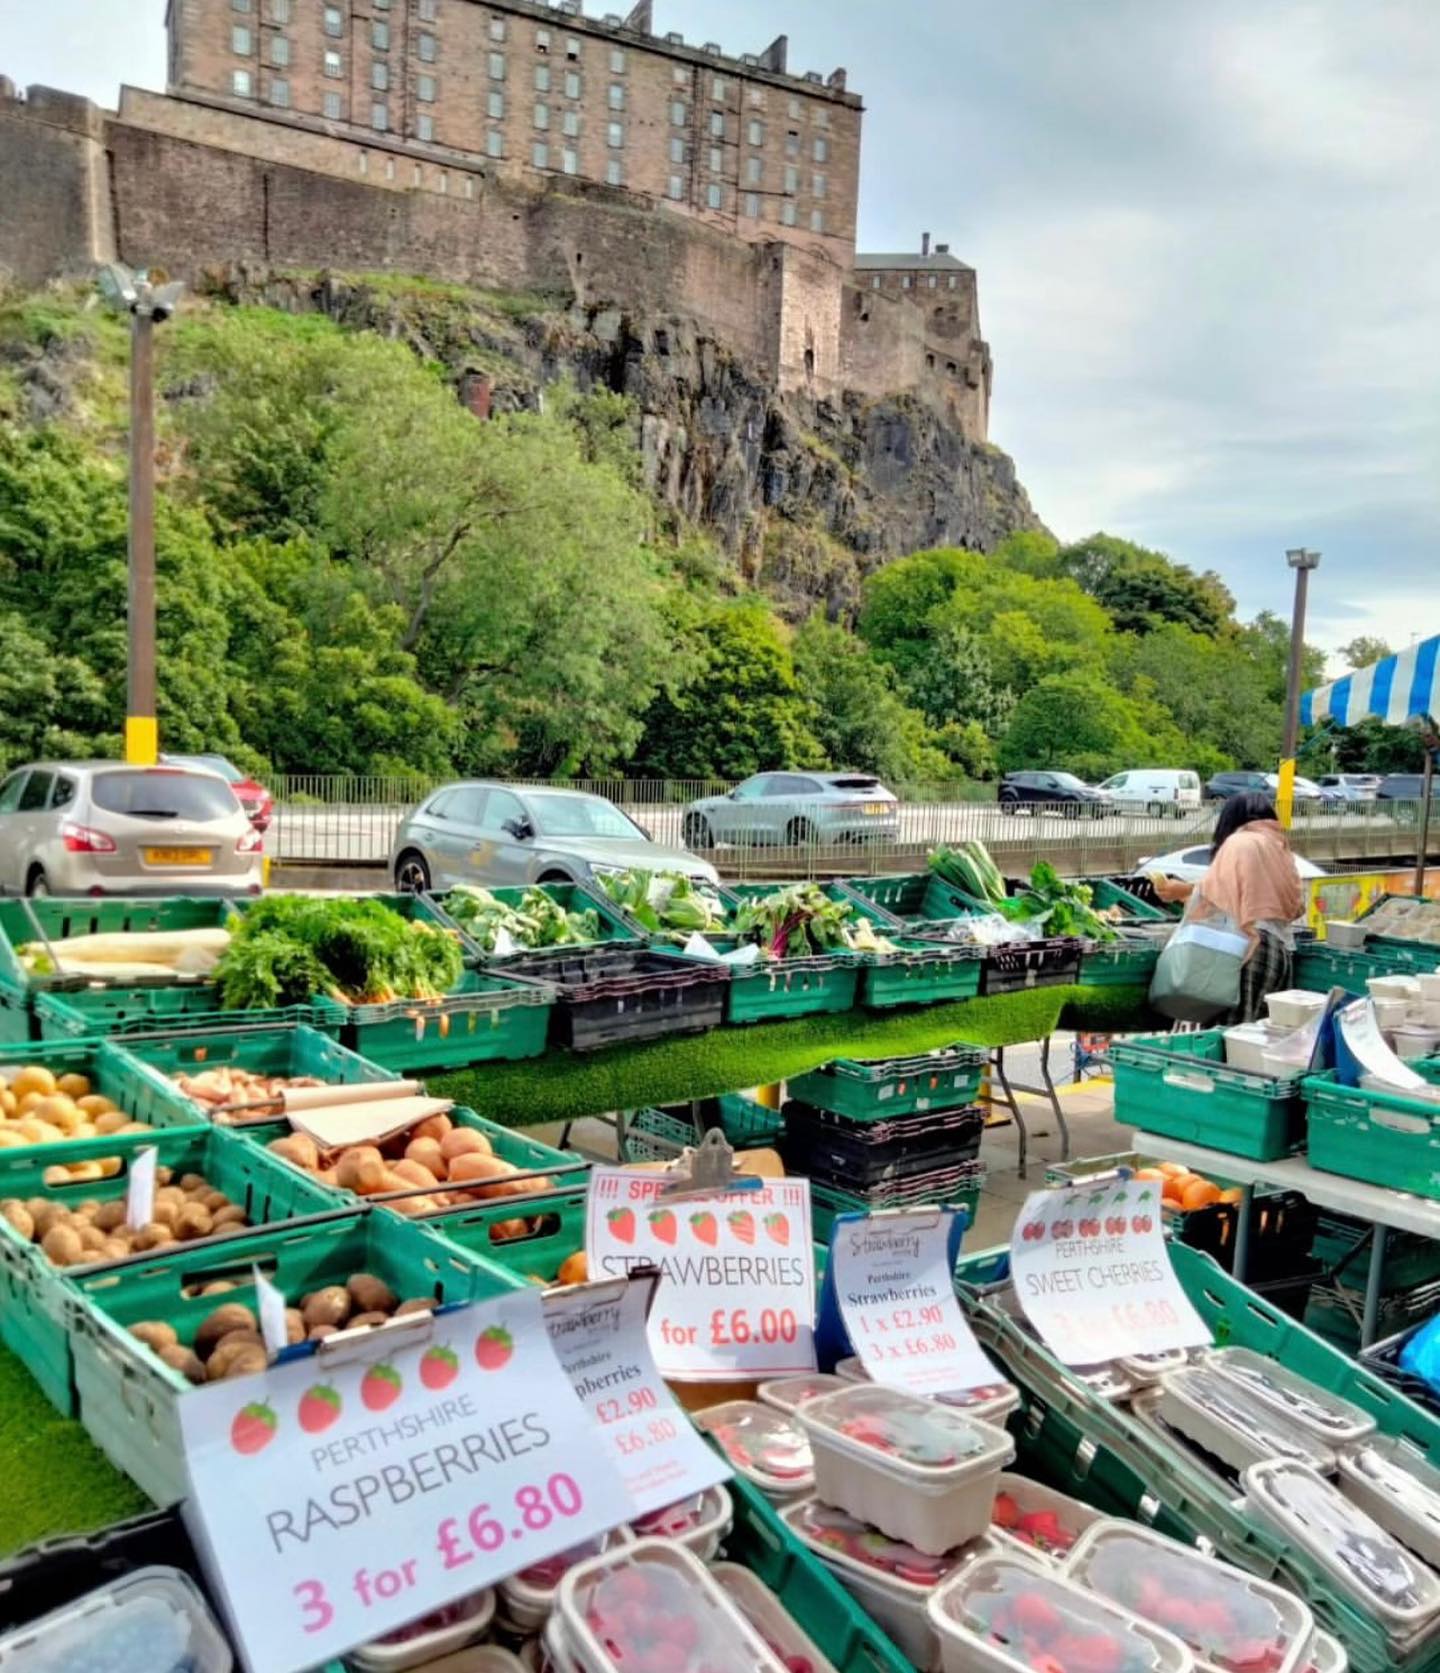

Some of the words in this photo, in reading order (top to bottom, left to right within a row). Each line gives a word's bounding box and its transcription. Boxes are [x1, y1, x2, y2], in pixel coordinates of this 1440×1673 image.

[1055, 1237, 1125, 1258] PERTHSHIRE
[847, 1284, 938, 1308] Strawberries
[1025, 1268, 1083, 1296] SWEET
[1087, 1260, 1165, 1290] CHERRIES
[661, 1319, 697, 1345] for
[710, 1307, 797, 1345] £6.00
[860, 1315, 870, 1334] 1
[876, 1317, 889, 1332] x
[892, 1304, 944, 1330] £2.90
[869, 1343, 883, 1361] 3
[889, 1343, 901, 1357] x
[904, 1332, 957, 1356] £6.80
[596, 1386, 657, 1424] £2.90
[309, 1394, 477, 1472] PERTHSHIRE
[614, 1417, 678, 1456] £6.80
[265, 1411, 551, 1553] RASPBERRIES
[293, 1578, 334, 1633] 3
[353, 1556, 418, 1607] for
[435, 1471, 585, 1570] £6.80
